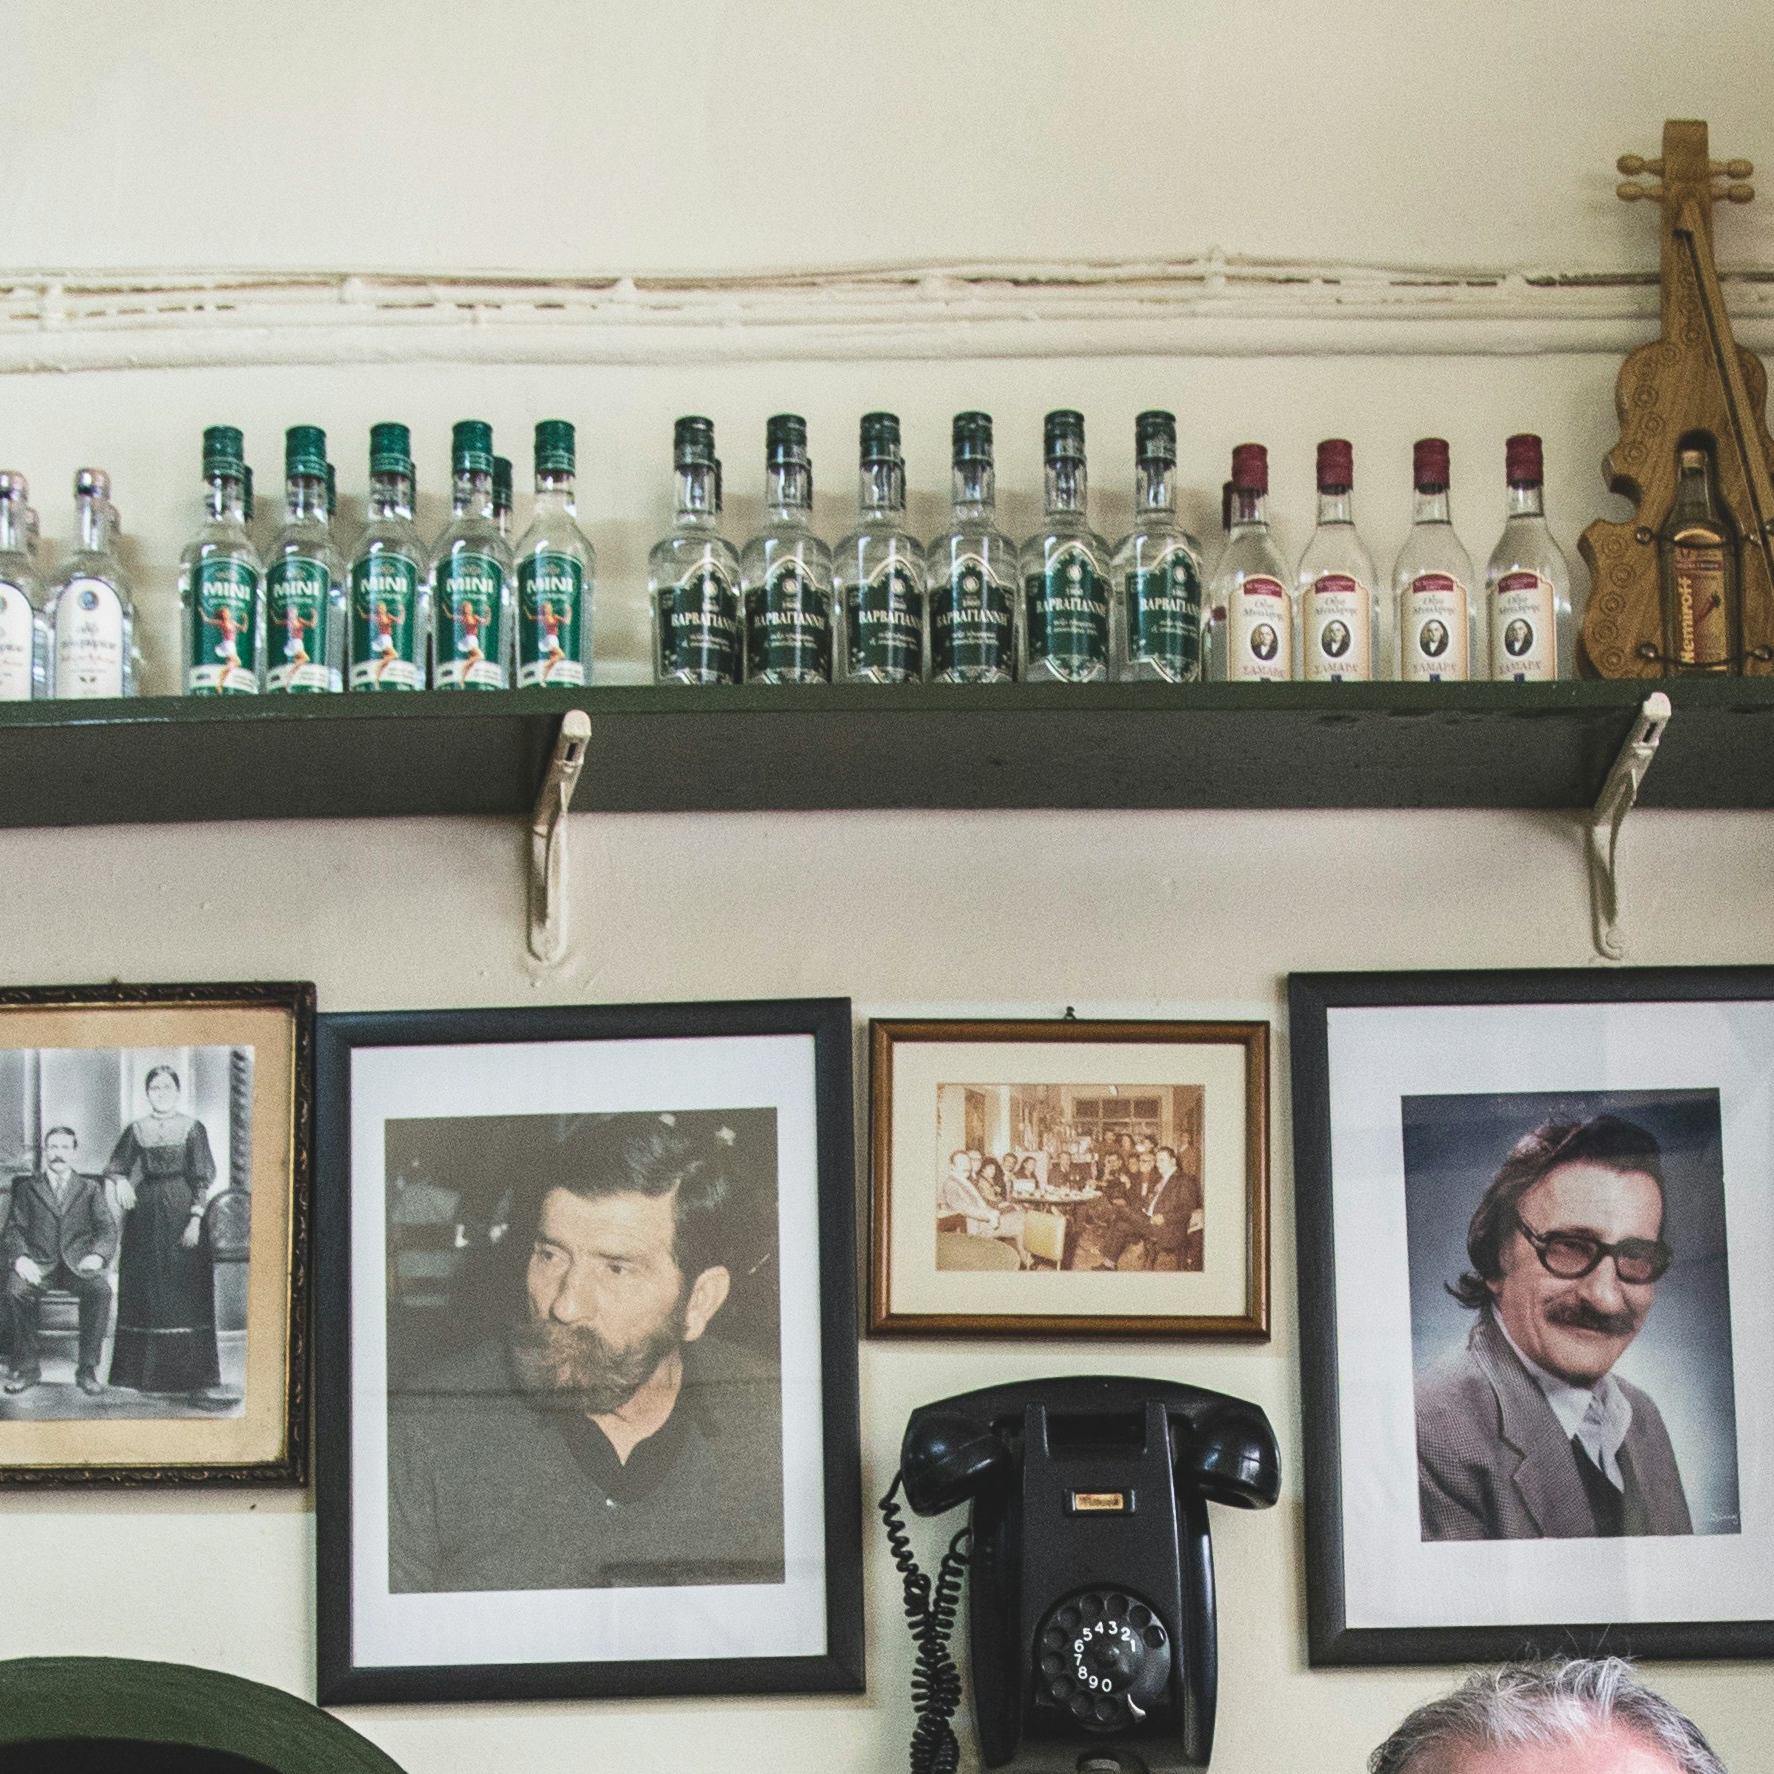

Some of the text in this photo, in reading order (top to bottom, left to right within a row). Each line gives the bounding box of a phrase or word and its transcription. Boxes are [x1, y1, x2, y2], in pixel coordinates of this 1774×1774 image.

[202, 579, 251, 601] MINI
[273, 578, 320, 597] MINI
[360, 576, 408, 595] MINI
[445, 576, 495, 594] MINI
[526, 577, 574, 595] MINI
[1678, 575, 1696, 664] Nemiroff
[1073, 1621, 1136, 1693] 1 2 3 4 5 6 7 8 9 0
